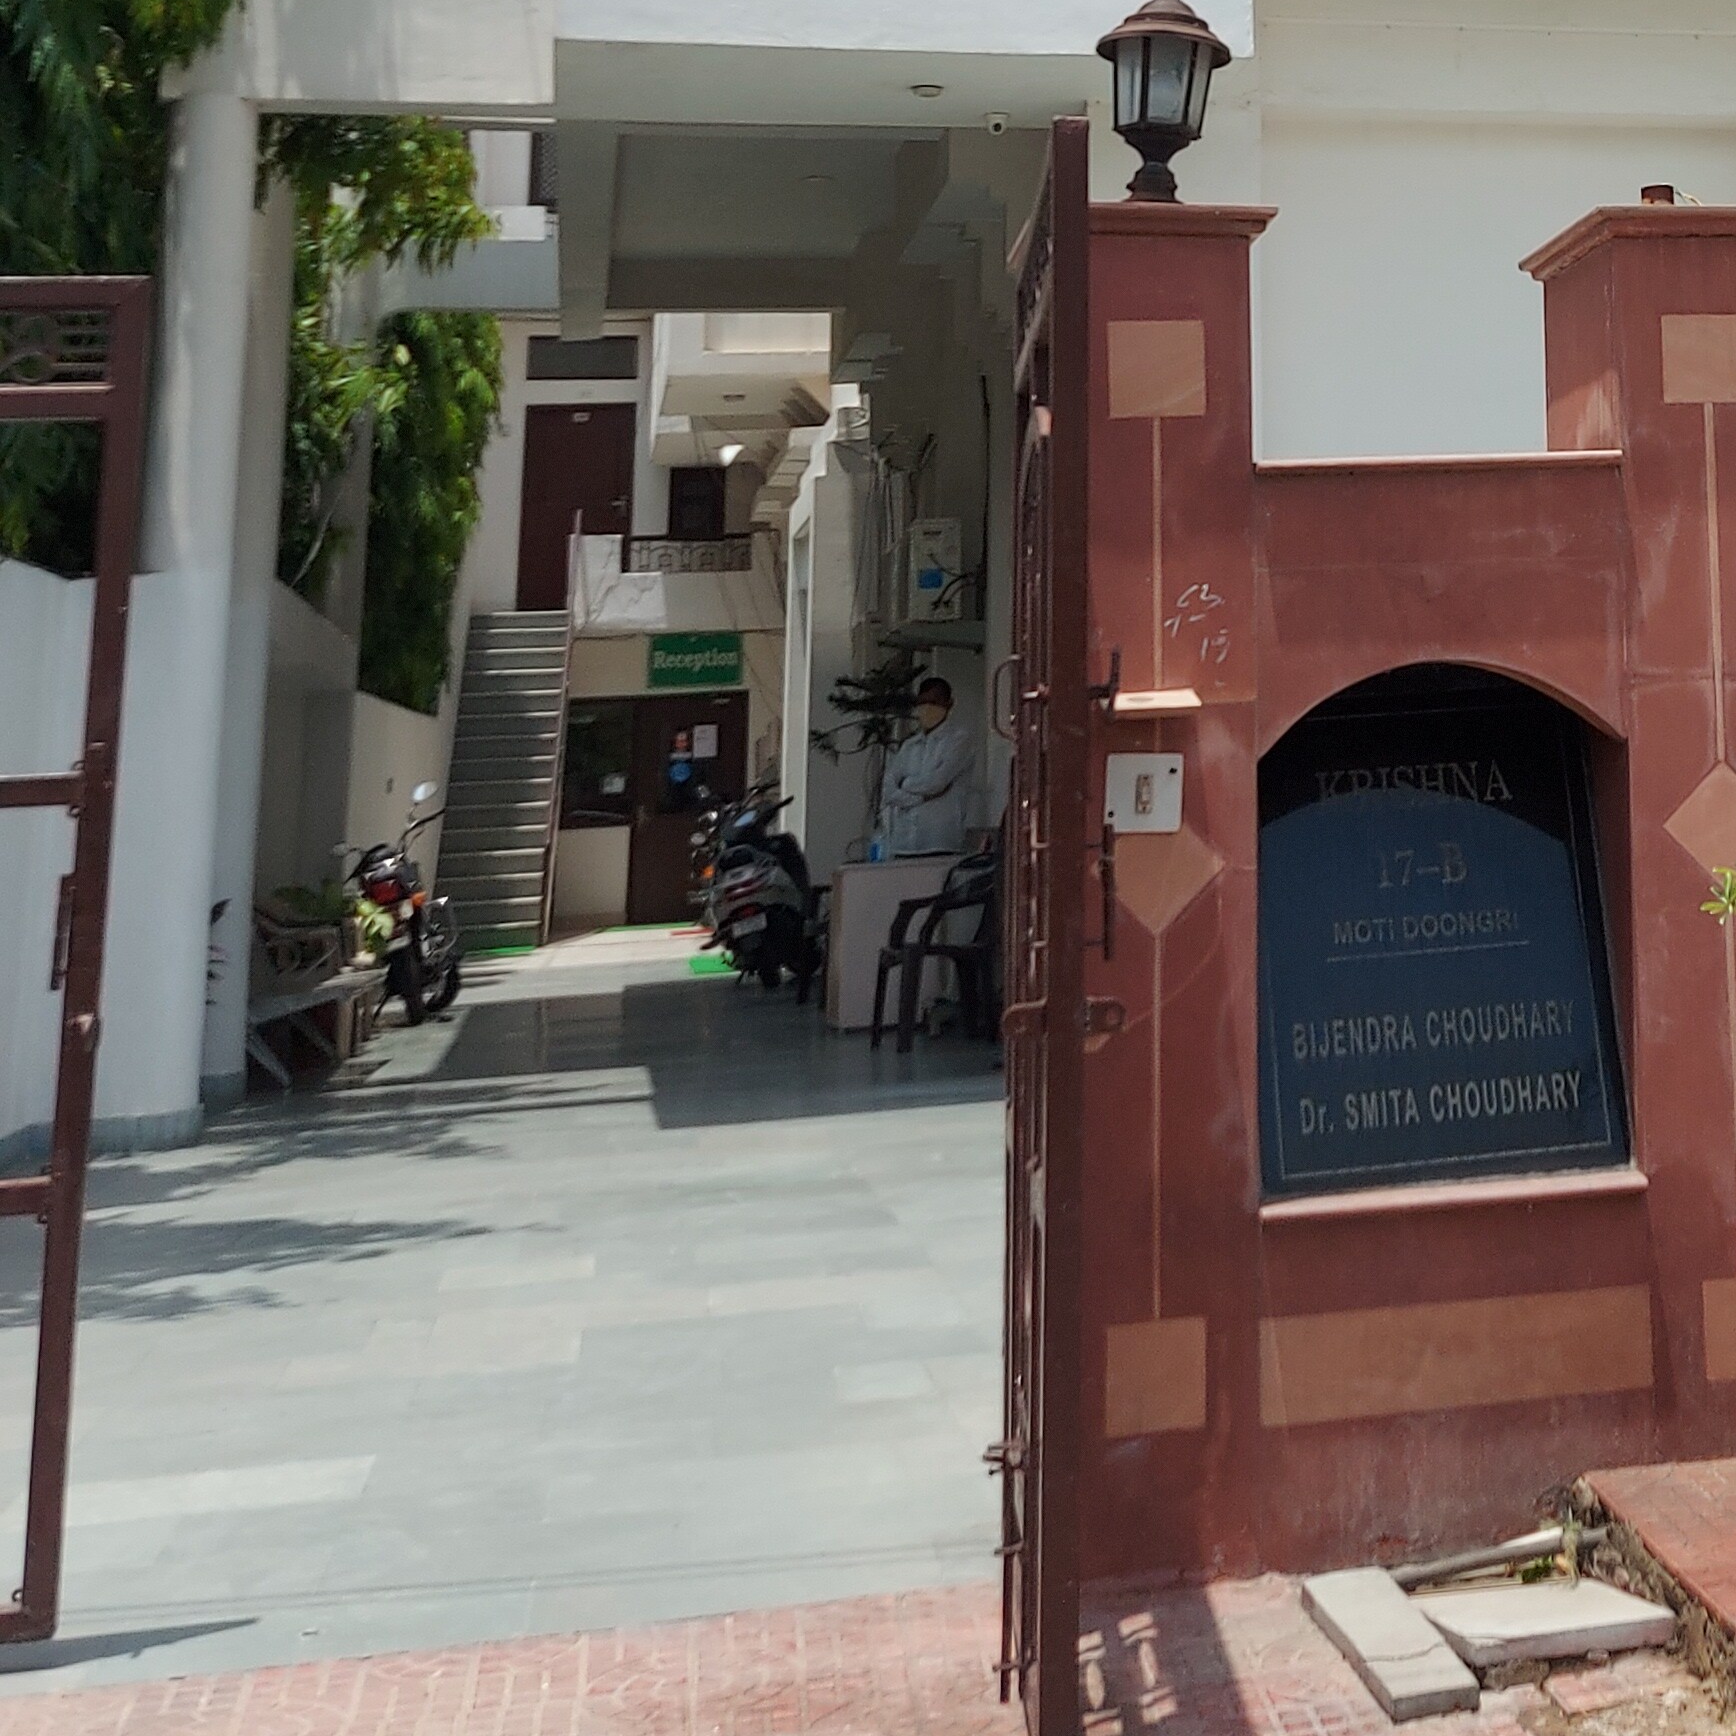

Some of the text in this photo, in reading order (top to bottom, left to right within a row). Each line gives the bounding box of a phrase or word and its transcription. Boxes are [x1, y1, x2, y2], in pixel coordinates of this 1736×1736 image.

[653, 647, 739, 672] Reception
[1314, 760, 1514, 804] KRISHNA
[1376, 841, 1468, 889] 17-B
[1333, 909, 1519, 945] MOTI DOONGRI
[1292, 1000, 1574, 1060] BIJENDRA CHOUDHARY
[1299, 1069, 1581, 1135] Dr. SMITA CHOUDHARY
